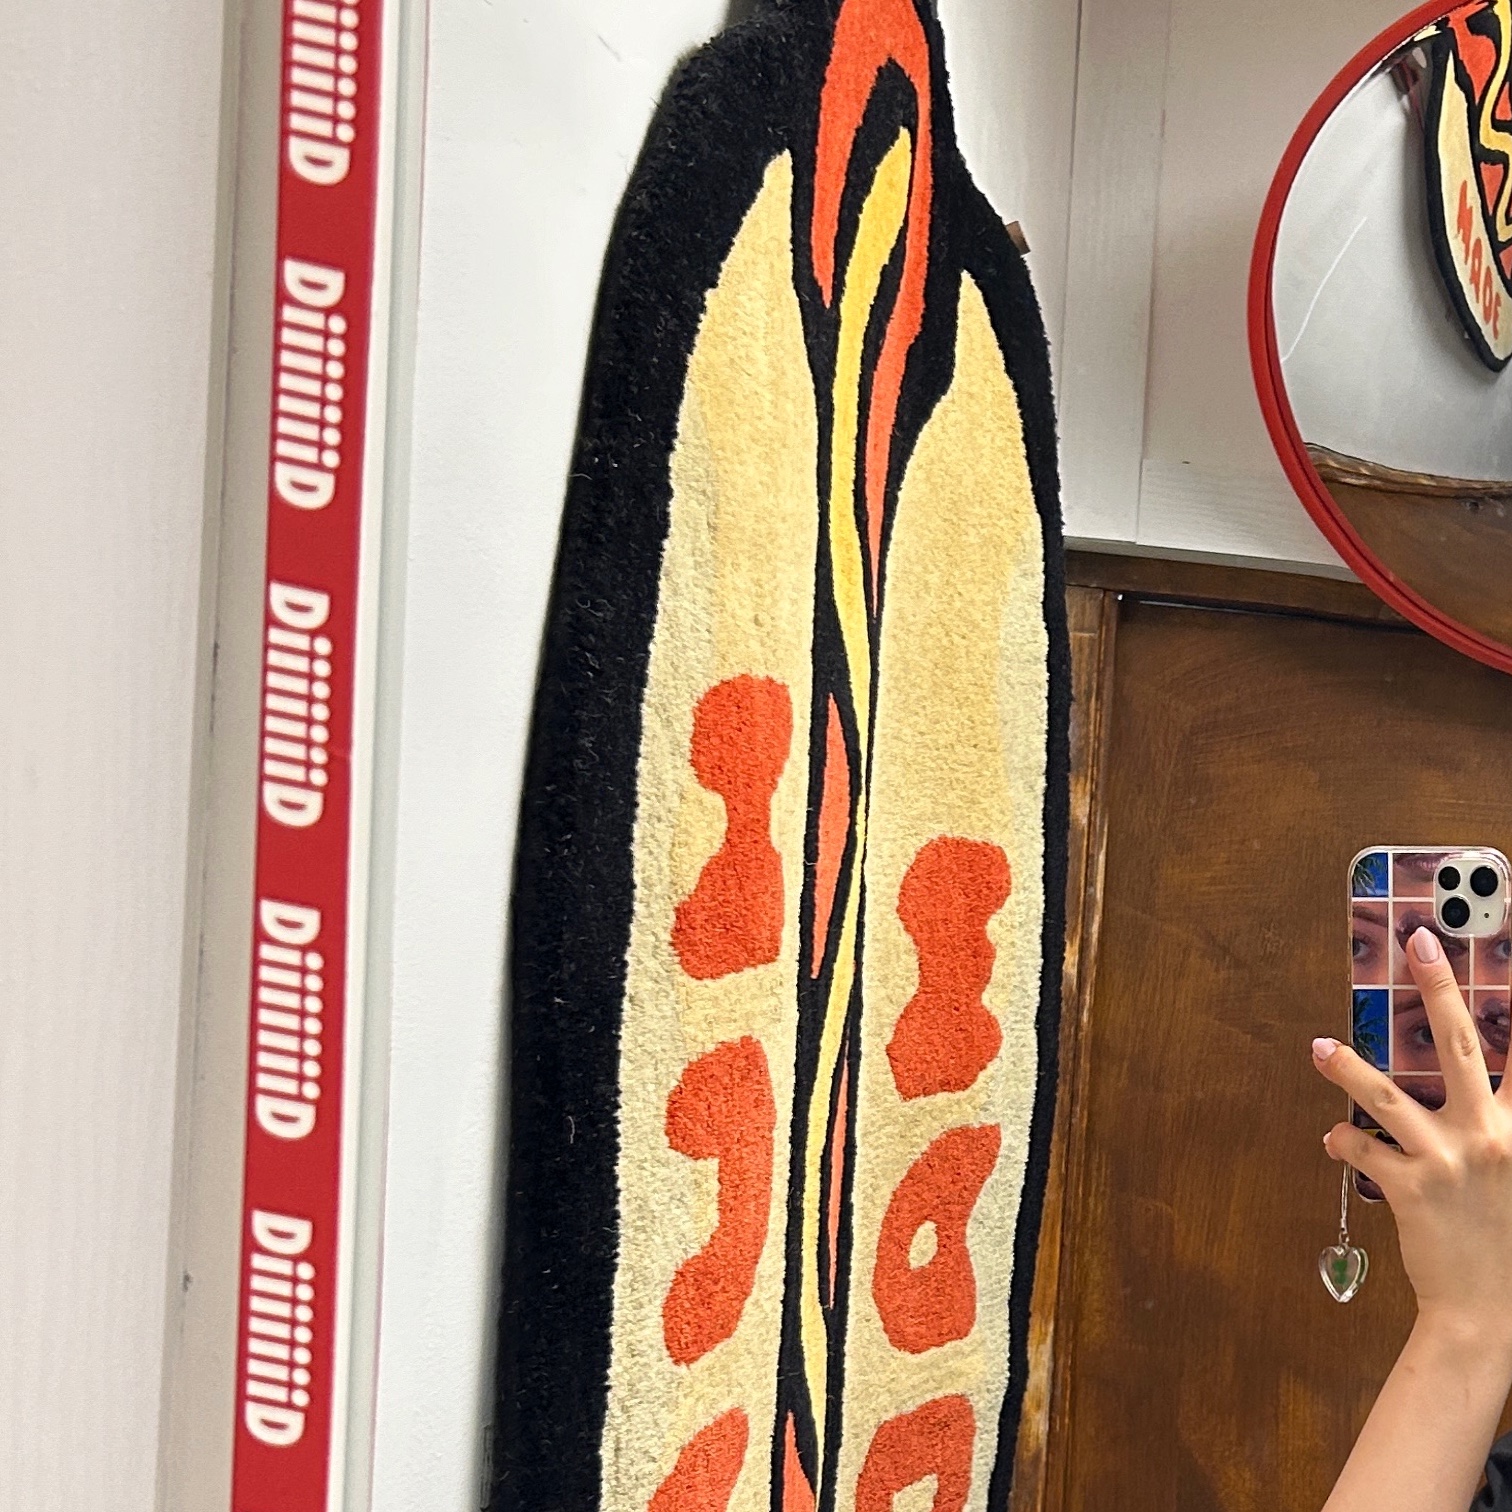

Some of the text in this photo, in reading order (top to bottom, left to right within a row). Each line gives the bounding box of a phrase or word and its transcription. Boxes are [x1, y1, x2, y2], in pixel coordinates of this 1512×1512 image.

[274, 259, 346, 509] DiiiiiiiD
[262, 582, 332, 827] DiiiiiiiD
[255, 899, 323, 1139] DiiiiiiiD
[245, 1210, 315, 1446] DiiiiiiiD
